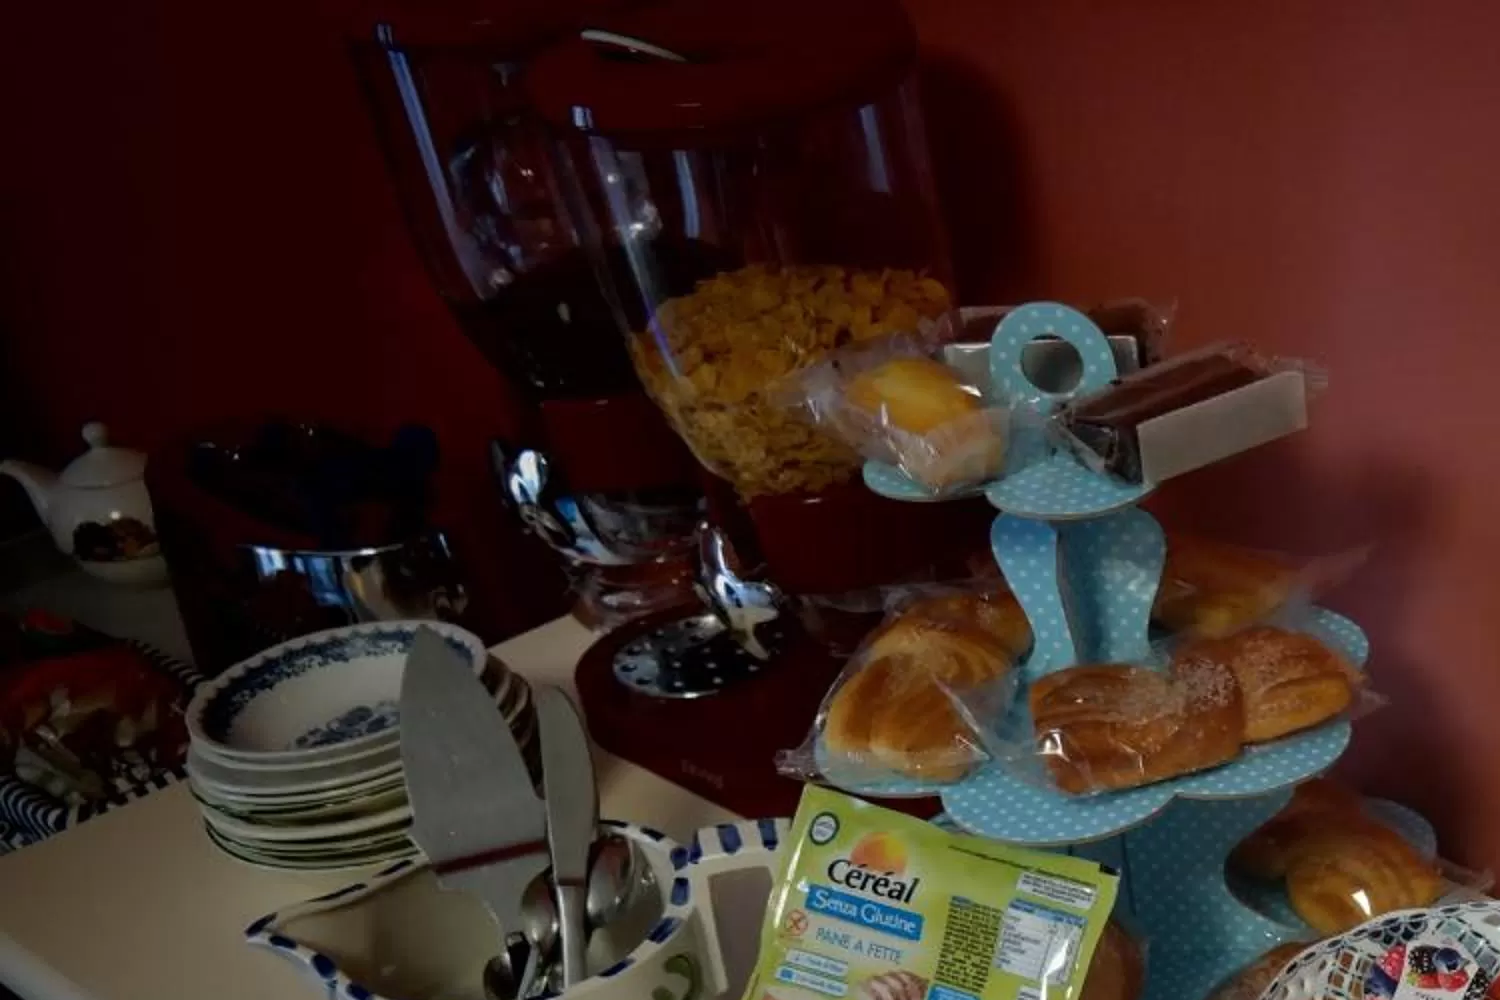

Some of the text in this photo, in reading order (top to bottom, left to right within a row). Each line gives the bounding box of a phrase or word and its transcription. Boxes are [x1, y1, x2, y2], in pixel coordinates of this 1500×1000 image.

[827, 858, 920, 903] Céréal
[812, 889, 917, 933] Senza Glutine
[815, 927, 850, 949] PANE
[852, 940, 863, 951] A
